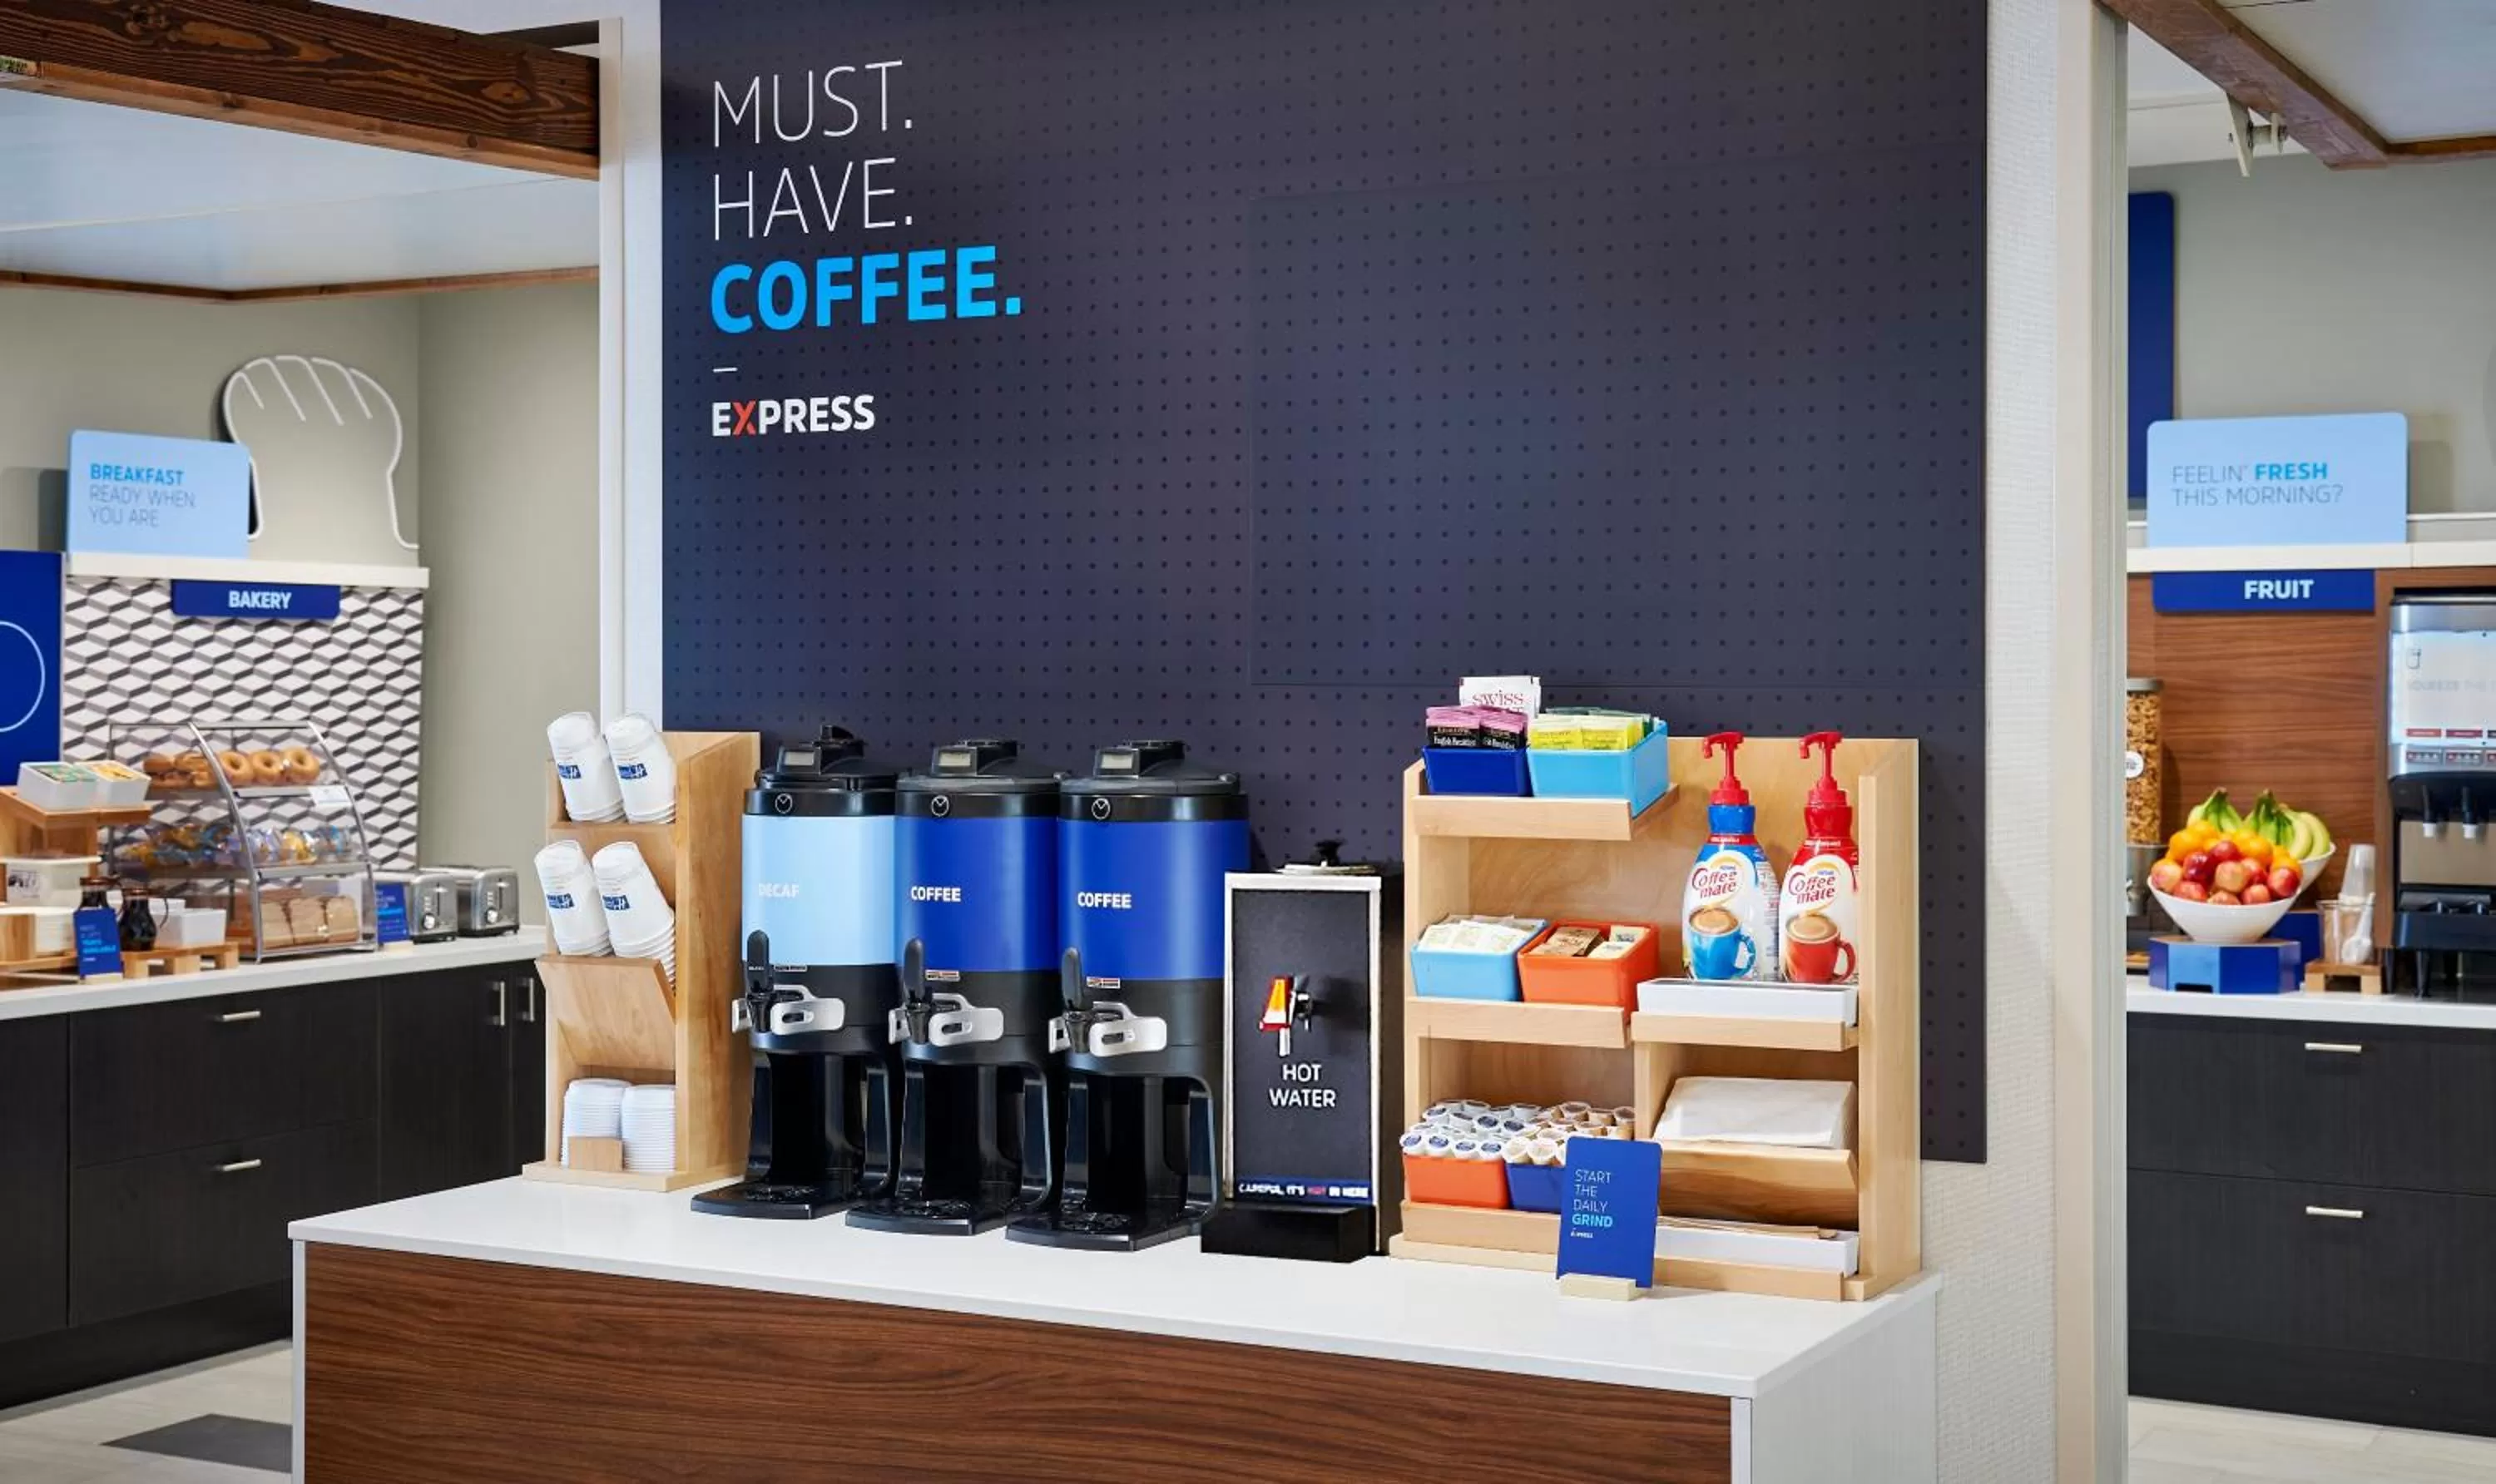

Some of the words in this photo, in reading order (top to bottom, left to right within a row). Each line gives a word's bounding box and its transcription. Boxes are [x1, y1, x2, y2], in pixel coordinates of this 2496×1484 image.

[714, 60, 913, 147] MUST.
[714, 156, 913, 240] HAVE.
[711, 245, 1022, 334] COFFEE.
[711, 395, 876, 437] EXPRESS
[90, 463, 185, 486] BREAKFAST
[2255, 462, 2328, 481] FRESH
[89, 483, 141, 504] READY
[147, 489, 196, 507] WHEN
[2171, 487, 2219, 506] THIS
[2226, 483, 2344, 506] MORNING?
[88, 505, 124, 524] YOU
[129, 508, 160, 527] ARE
[2244, 579, 2315, 600] FRUIT
[229, 590, 292, 609] BAKERY
[1472, 690, 1523, 705] swiss
[1692, 868, 1737, 891] Coffee
[1789, 872, 1835, 895] Coffee
[758, 883, 800, 898] DECAF
[911, 886, 961, 903] COFFEE
[1700, 881, 1736, 898] mate
[1796, 887, 1835, 904] mate
[1077, 892, 1132, 909] COFFEE
[1282, 1064, 1322, 1081] HOT
[1269, 1088, 1336, 1107] WATER
[1575, 1169, 1612, 1184] START
[1574, 1185, 1597, 1197] THE
[1573, 1199, 1608, 1213] DAILY
[1572, 1214, 1613, 1227] GRIND
